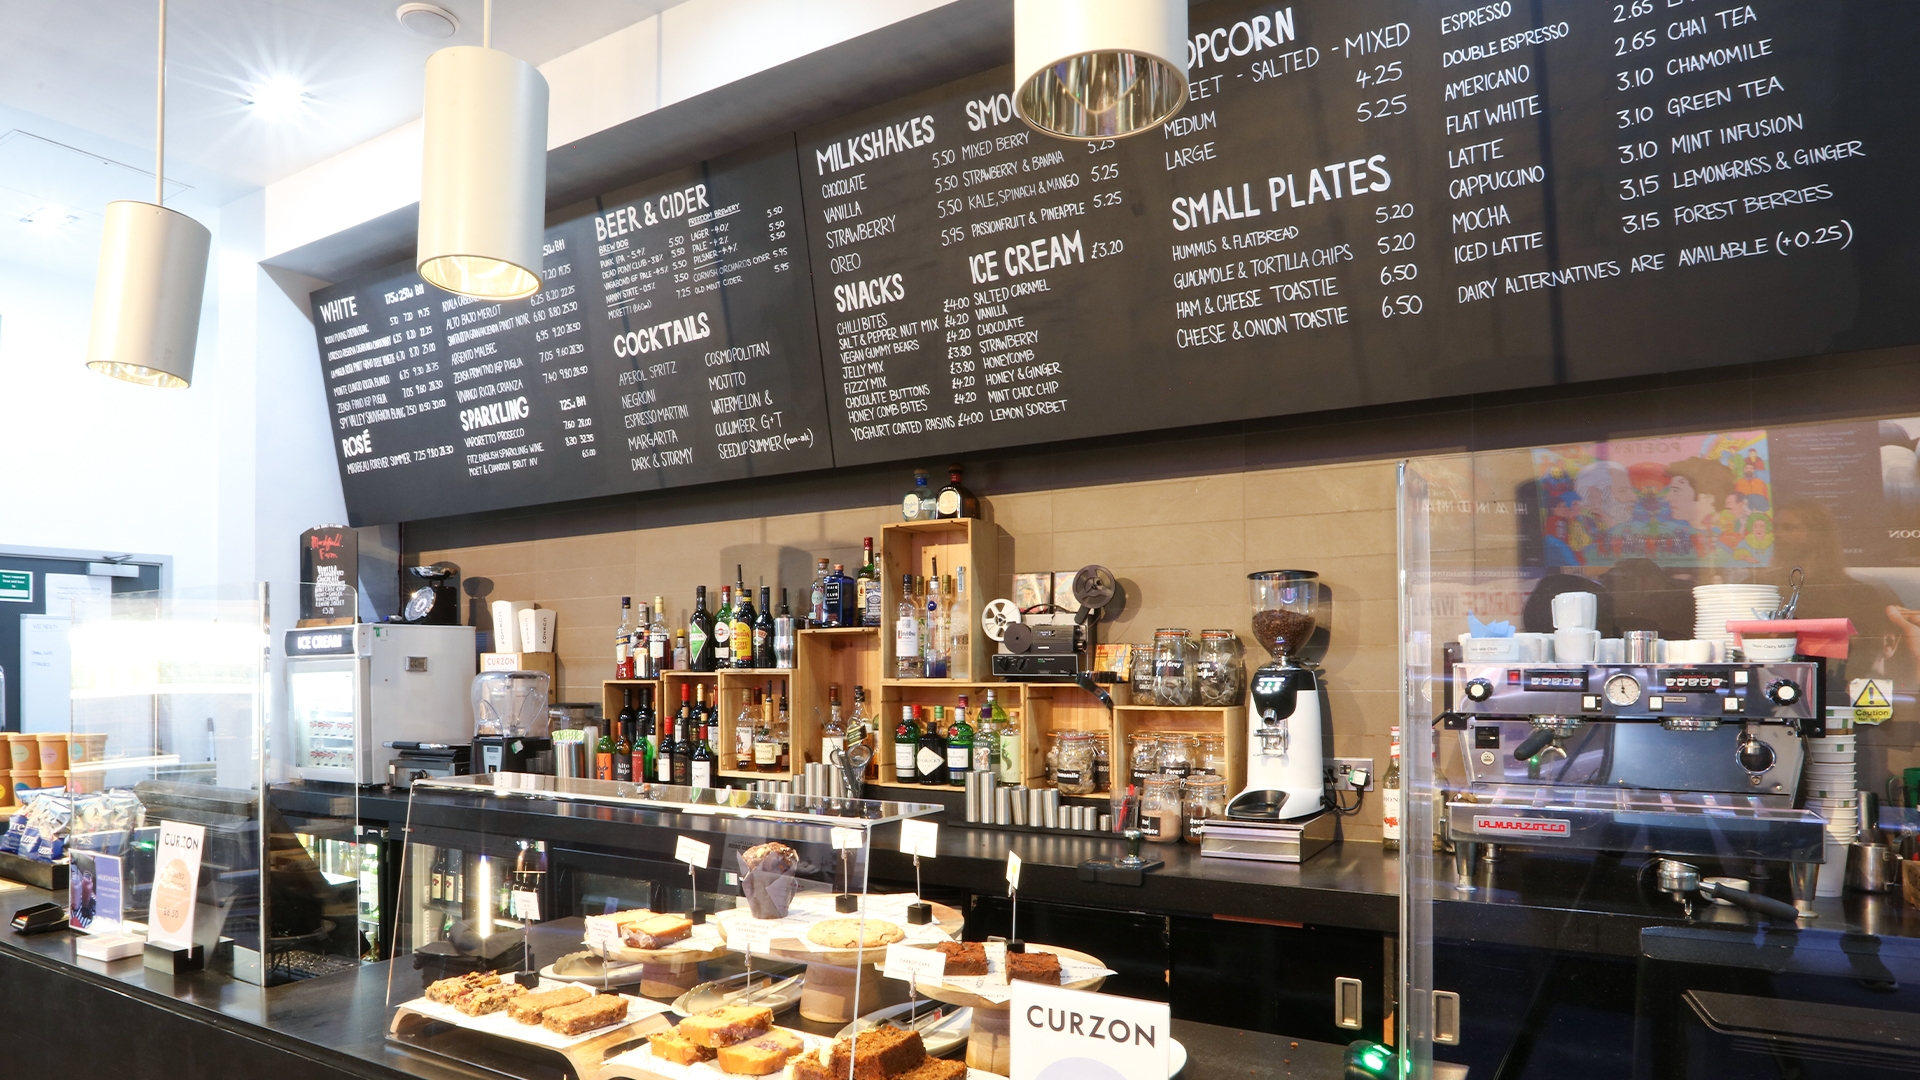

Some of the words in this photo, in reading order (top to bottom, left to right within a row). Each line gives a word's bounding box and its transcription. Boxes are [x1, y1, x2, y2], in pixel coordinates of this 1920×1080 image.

[1441, 0, 1511, 35] ESPRESSO
[1443, 41, 1499, 68] DOUBLE
[1500, 21, 1569, 53] ESPRESSO
[1613, 0, 1653, 23] 2.65
[1667, 16, 1707, 41] CHAI
[1714, 5, 1757, 29] TEA
[1251, 46, 1320, 83] SALTED
[1445, 64, 1530, 102] AMERICANO
[1614, 28, 1656, 57] 2.65
[1666, 38, 1773, 76] CHAMOMILE
[1163, 110, 1217, 140] MEDIUM
[1356, 61, 1403, 89] 4.25
[1446, 110, 1481, 136] FLAT
[1484, 94, 1542, 126] WHITE
[1617, 67, 1654, 91] 3.10
[816, 114, 935, 176] MILKSHAKES
[961, 139, 993, 160] MIXED
[995, 130, 1030, 152] BERRY
[1448, 138, 1504, 169] LATTE
[1616, 106, 1653, 129] 3.10
[821, 173, 868, 199] CHOCOLATE
[932, 149, 956, 169] 5.50
[962, 160, 1018, 187] STRAWBERRY
[1022, 158, 1031, 173] &
[1031, 150, 1065, 171] BANANA
[1449, 165, 1545, 200] CAPPUCCINO
[1618, 140, 1658, 164] 3.10
[1673, 156, 1772, 189] LEMONGRASS
[1776, 151, 1792, 170] &
[1794, 140, 1865, 166] GINGER
[823, 200, 863, 224] VANILLA
[935, 174, 959, 194] 5.50
[1171, 182, 1261, 232] SMALL
[1268, 154, 1391, 212] PLATES
[1452, 204, 1511, 234] MOCHA
[1619, 174, 1659, 201] 3.15
[594, 206, 643, 242] BEER
[643, 201, 659, 226] &
[659, 183, 710, 220] CIDER
[825, 214, 896, 249] STRAWBERRY
[937, 198, 963, 219] 5.50
[970, 214, 1026, 238] PASSIONFRUIT
[1028, 210, 1038, 225] &
[1040, 202, 1085, 221] PINEAPPLE
[1093, 190, 1122, 209] 5.25
[830, 252, 862, 275] OREO
[941, 226, 965, 247] 5.95
[1454, 241, 1488, 264] ICED
[1492, 231, 1543, 256] LATTE
[1622, 211, 1660, 234] 3.15
[692, 268, 719, 283] CORNISH
[752, 252, 771, 265] CIDER
[772, 247, 788, 258] 5.95
[722, 275, 743, 286] CIDER
[773, 262, 789, 273] 5.95
[968, 250, 1000, 285] ICE
[1004, 229, 1085, 277] CREAM
[1091, 239, 1124, 260] £3.20
[1458, 277, 1498, 304] DAIRY
[1505, 260, 1621, 294] ALTERNATIVES
[1631, 253, 1665, 273] ARE
[1678, 237, 1769, 267] AVAILABLE
[1776, 219, 1853, 256] (+0.25)
[319, 295, 358, 323] WHITE
[833, 273, 905, 313] SNACKS
[973, 286, 1010, 306] SALTED
[1010, 278, 1051, 298] CARAMEL
[1176, 298, 1202, 319] HAM
[1204, 296, 1216, 315] &
[1216, 288, 1263, 313] CHEESE
[1269, 276, 1338, 303] TOASTIE
[1380, 263, 1417, 286] 6.50
[613, 311, 711, 358] COCKTAILS
[704, 340, 771, 367] COSMOPOLITAN
[618, 369, 648, 387] APEROL
[648, 360, 678, 379] SPRITZ
[708, 371, 746, 392] MOJITO
[845, 391, 887, 409] CHOCOLATE
[888, 383, 931, 402] BUTTONS
[951, 375, 976, 390] £4.20
[459, 395, 530, 432] SPARKLING
[621, 388, 657, 409] NEGRONI
[624, 409, 658, 429] ESPRESSO
[656, 404, 689, 422] MARTINI
[710, 392, 762, 415] WATERMELON
[764, 389, 773, 406] &
[989, 405, 1025, 422] LEMON
[1025, 399, 1068, 417] SORBET
[627, 429, 679, 451] MARGARITA
[715, 416, 759, 437] CUCUMBER
[760, 411, 783, 430] G+T
[850, 423, 890, 442] YOGHURT
[892, 420, 923, 435] COATED
[924, 415, 956, 431] RAISINS
[957, 411, 984, 427] £4.00
[341, 428, 373, 458] ROSÉ
[298, 636, 312, 650] ICE
[312, 634, 342, 649] CREAM
[487, 658, 515, 666] CURZON
[164, 832, 199, 850] CURZON
[1026, 1004, 1156, 1048] CURZON
